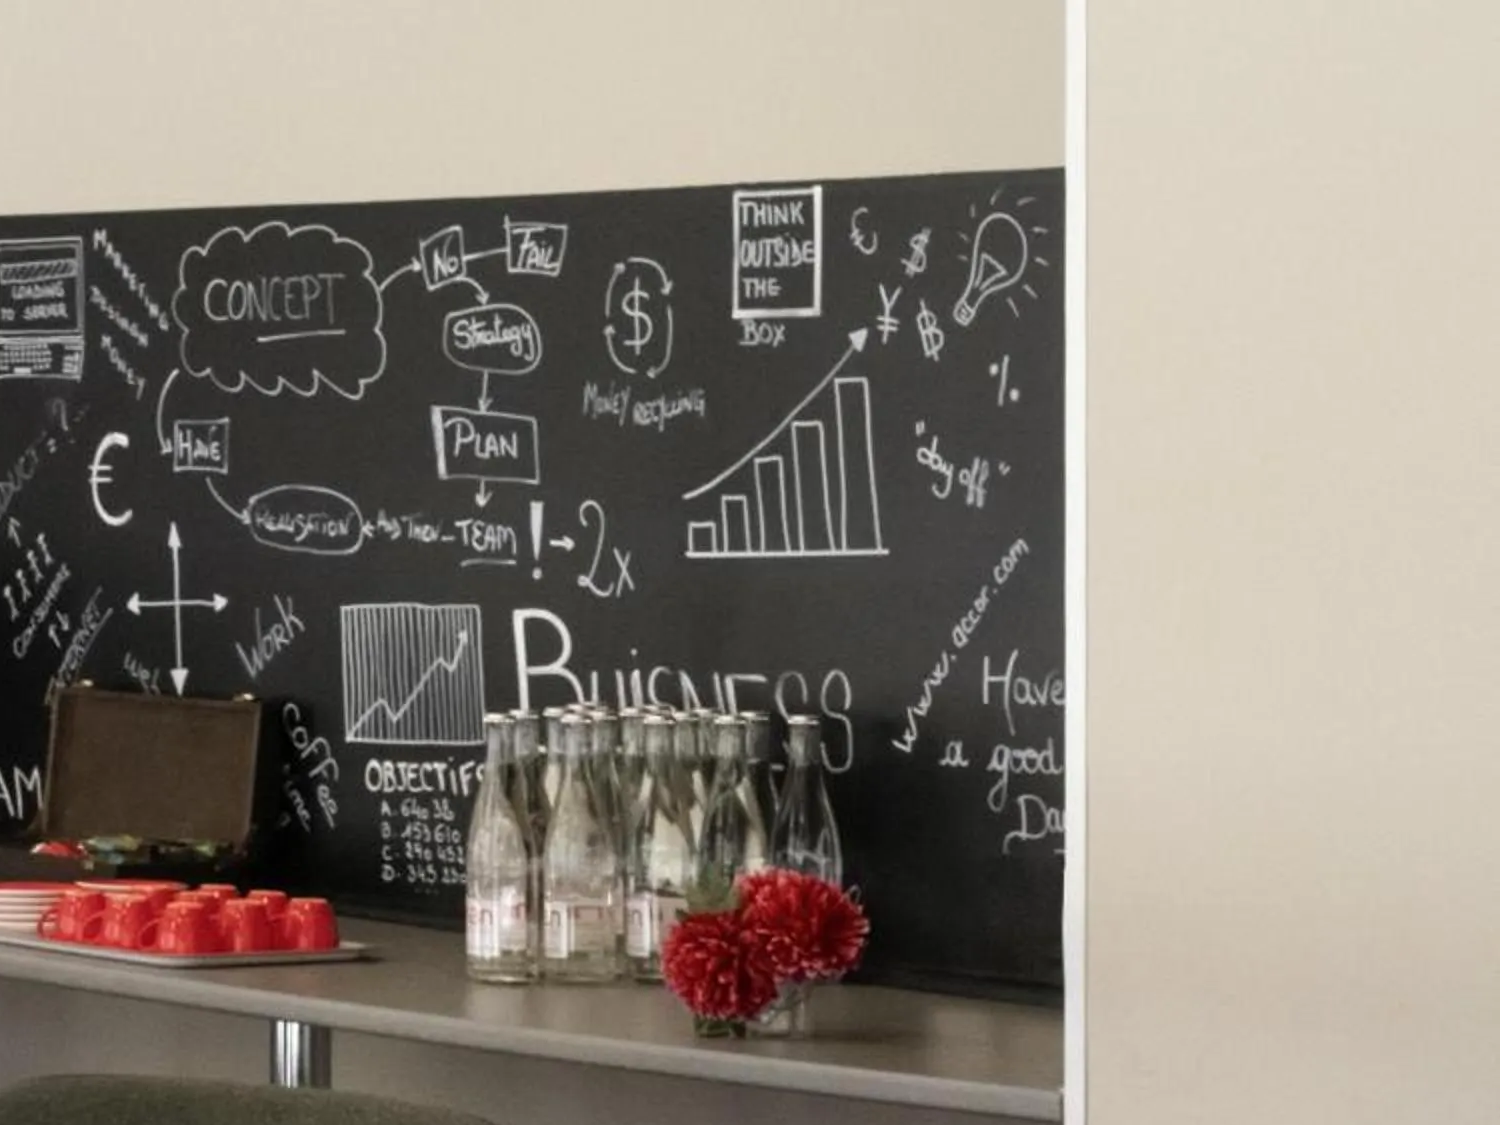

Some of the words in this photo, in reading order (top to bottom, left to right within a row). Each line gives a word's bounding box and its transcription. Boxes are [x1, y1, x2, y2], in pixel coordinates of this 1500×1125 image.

[740, 200, 805, 228] THINK
[740, 233, 816, 268] OUTSIDE
[203, 272, 346, 324] CONCEPT
[742, 276, 782, 299] THE
[452, 318, 535, 362] Strategy
[443, 416, 518, 458] PLAN
[454, 518, 517, 555] TEAM
[235, 593, 306, 681] WORK
[980, 648, 1066, 737] Have
[939, 741, 970, 768] a
[986, 738, 1067, 814] good
